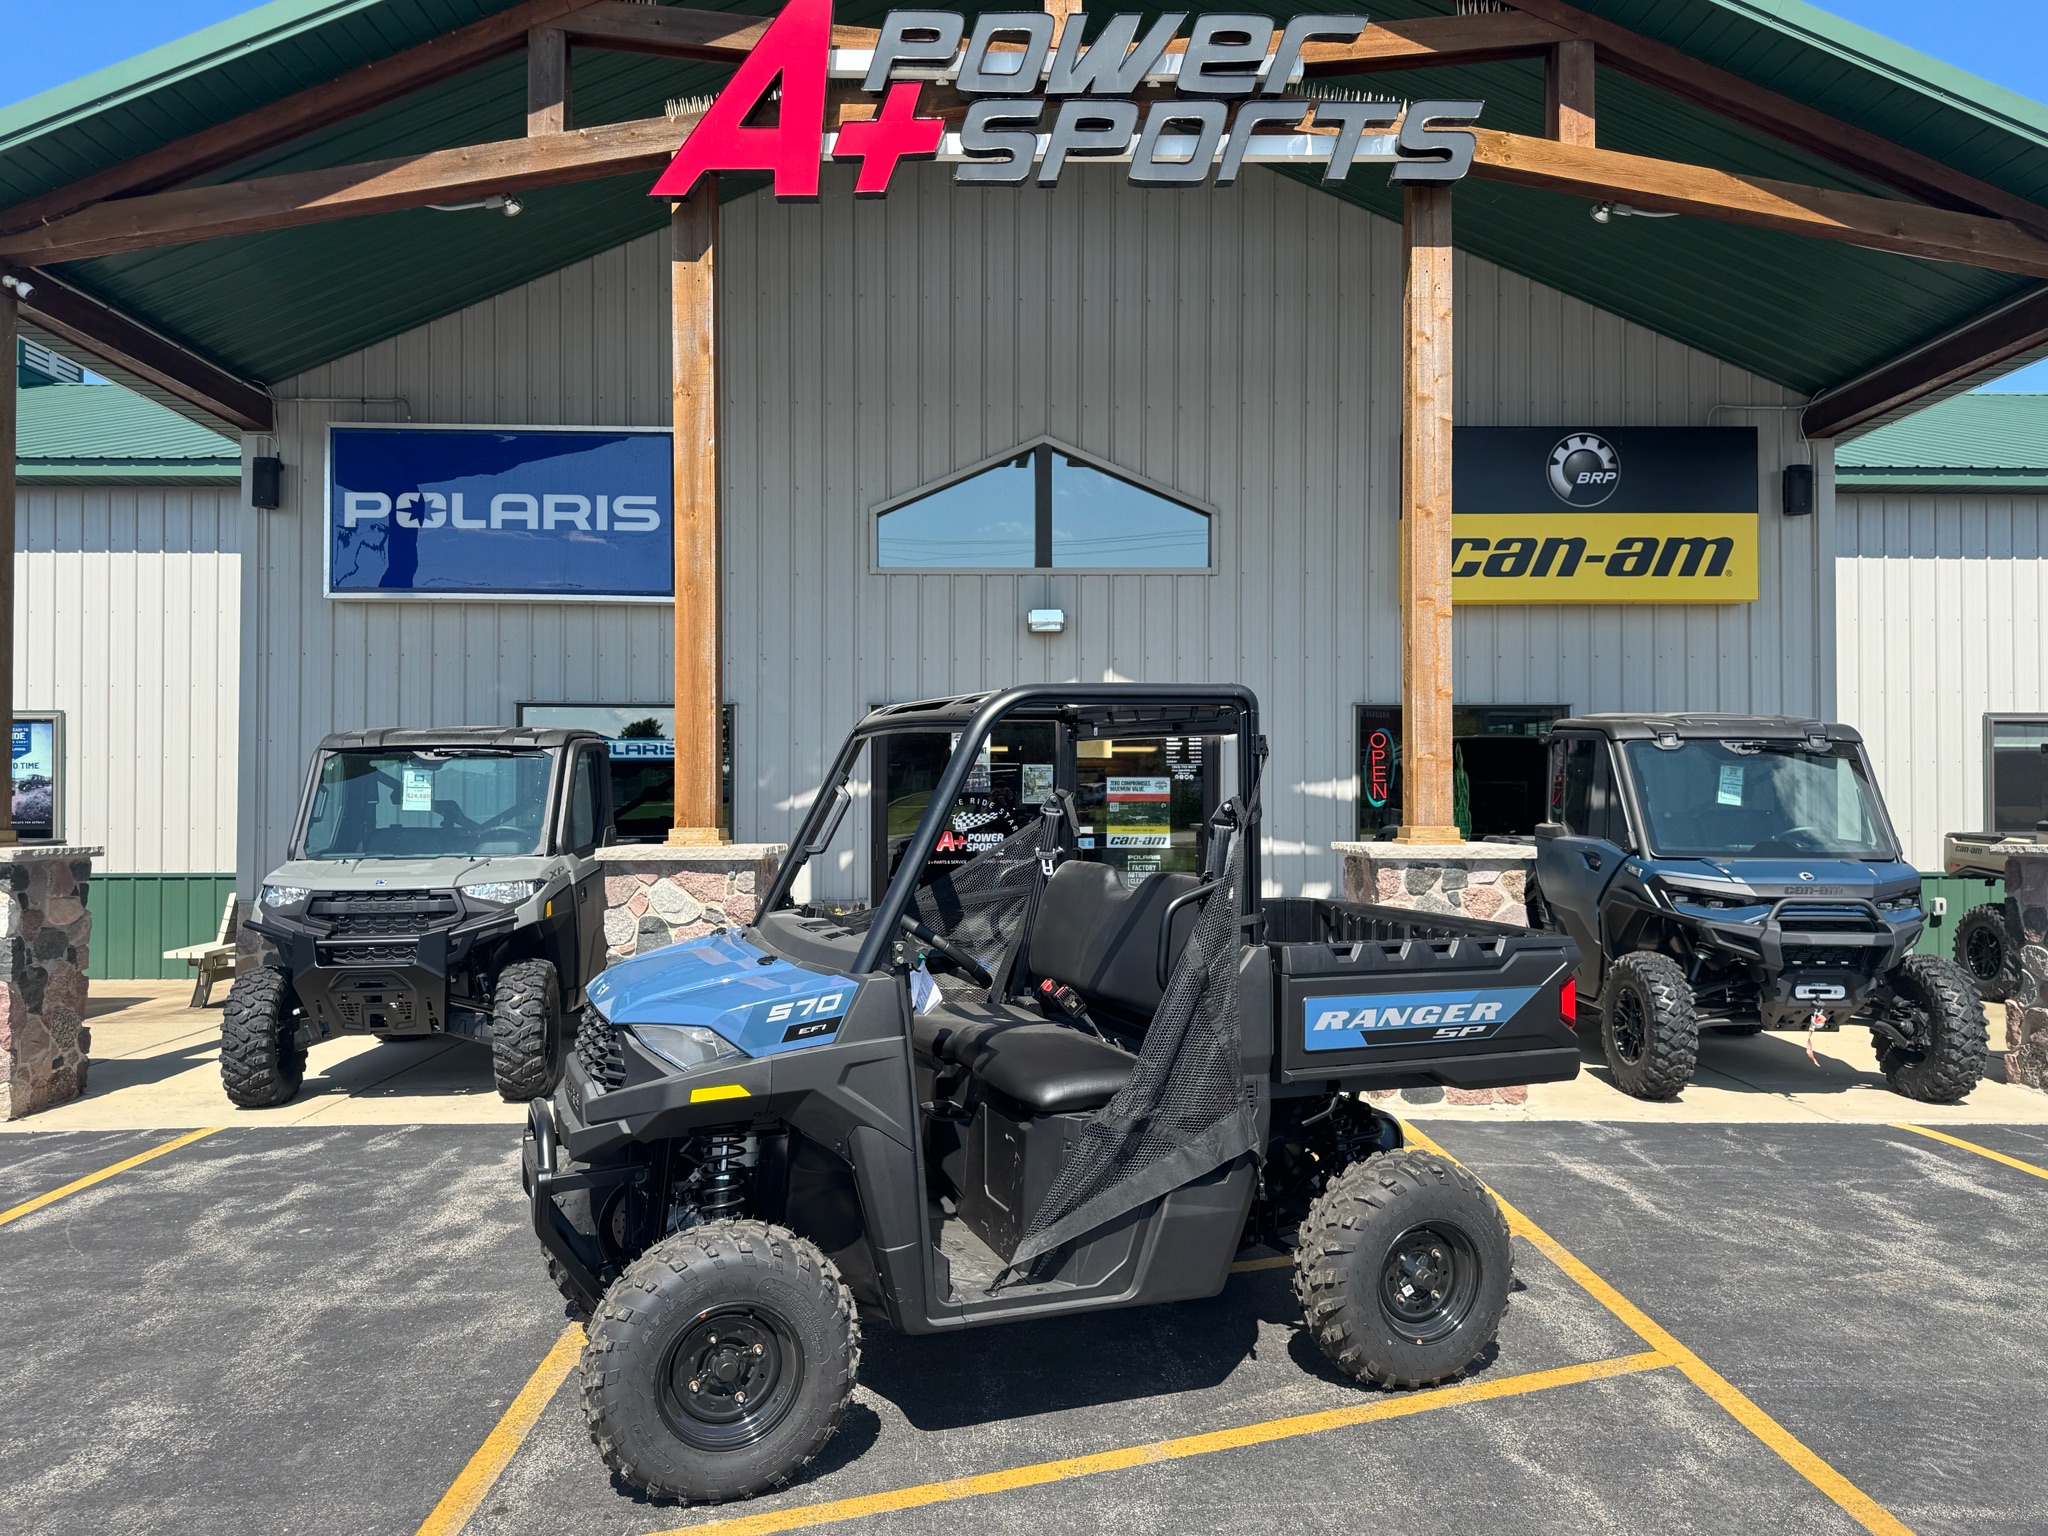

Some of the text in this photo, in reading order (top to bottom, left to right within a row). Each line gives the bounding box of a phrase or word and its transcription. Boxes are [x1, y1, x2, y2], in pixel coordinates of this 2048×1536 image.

[1576, 471, 1617, 485] BRP
[344, 491, 661, 532] POLARIS
[611, 742, 675, 756] LARIS
[20, 762, 40, 770] TIME
[1369, 732, 1388, 799] OPEN
[970, 797, 995, 809] RIDE
[936, 830, 968, 852] A+
[967, 833, 1005, 843] POWER
[1109, 836, 1167, 845] can-am
[548, 865, 565, 880] XP
[766, 993, 843, 1023] 570
[1313, 1002, 1502, 1031] RANGER
[798, 1024, 827, 1035] EFI
[1432, 1025, 1487, 1039] SP
